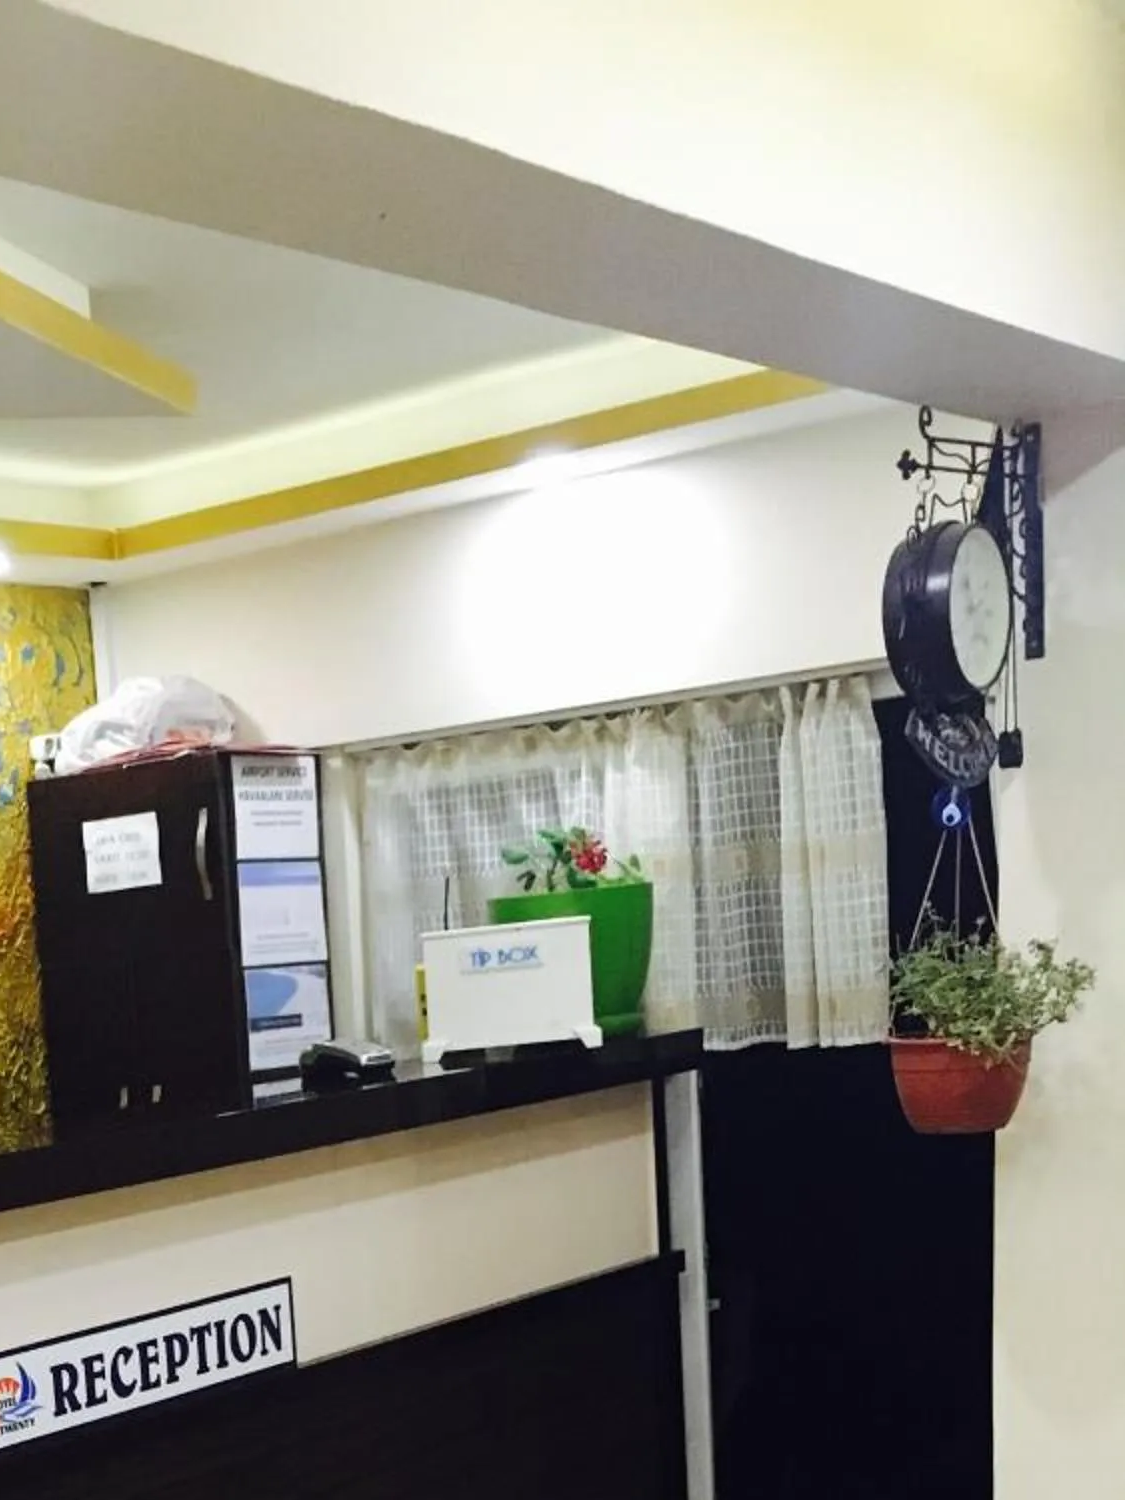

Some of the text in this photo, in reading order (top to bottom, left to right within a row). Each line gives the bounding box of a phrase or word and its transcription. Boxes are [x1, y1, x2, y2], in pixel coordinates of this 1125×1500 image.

[498, 945, 538, 965] BOX
[50, 1304, 283, 1417] RECEPTION
[0, 1418, 36, 1435] TWENTY
